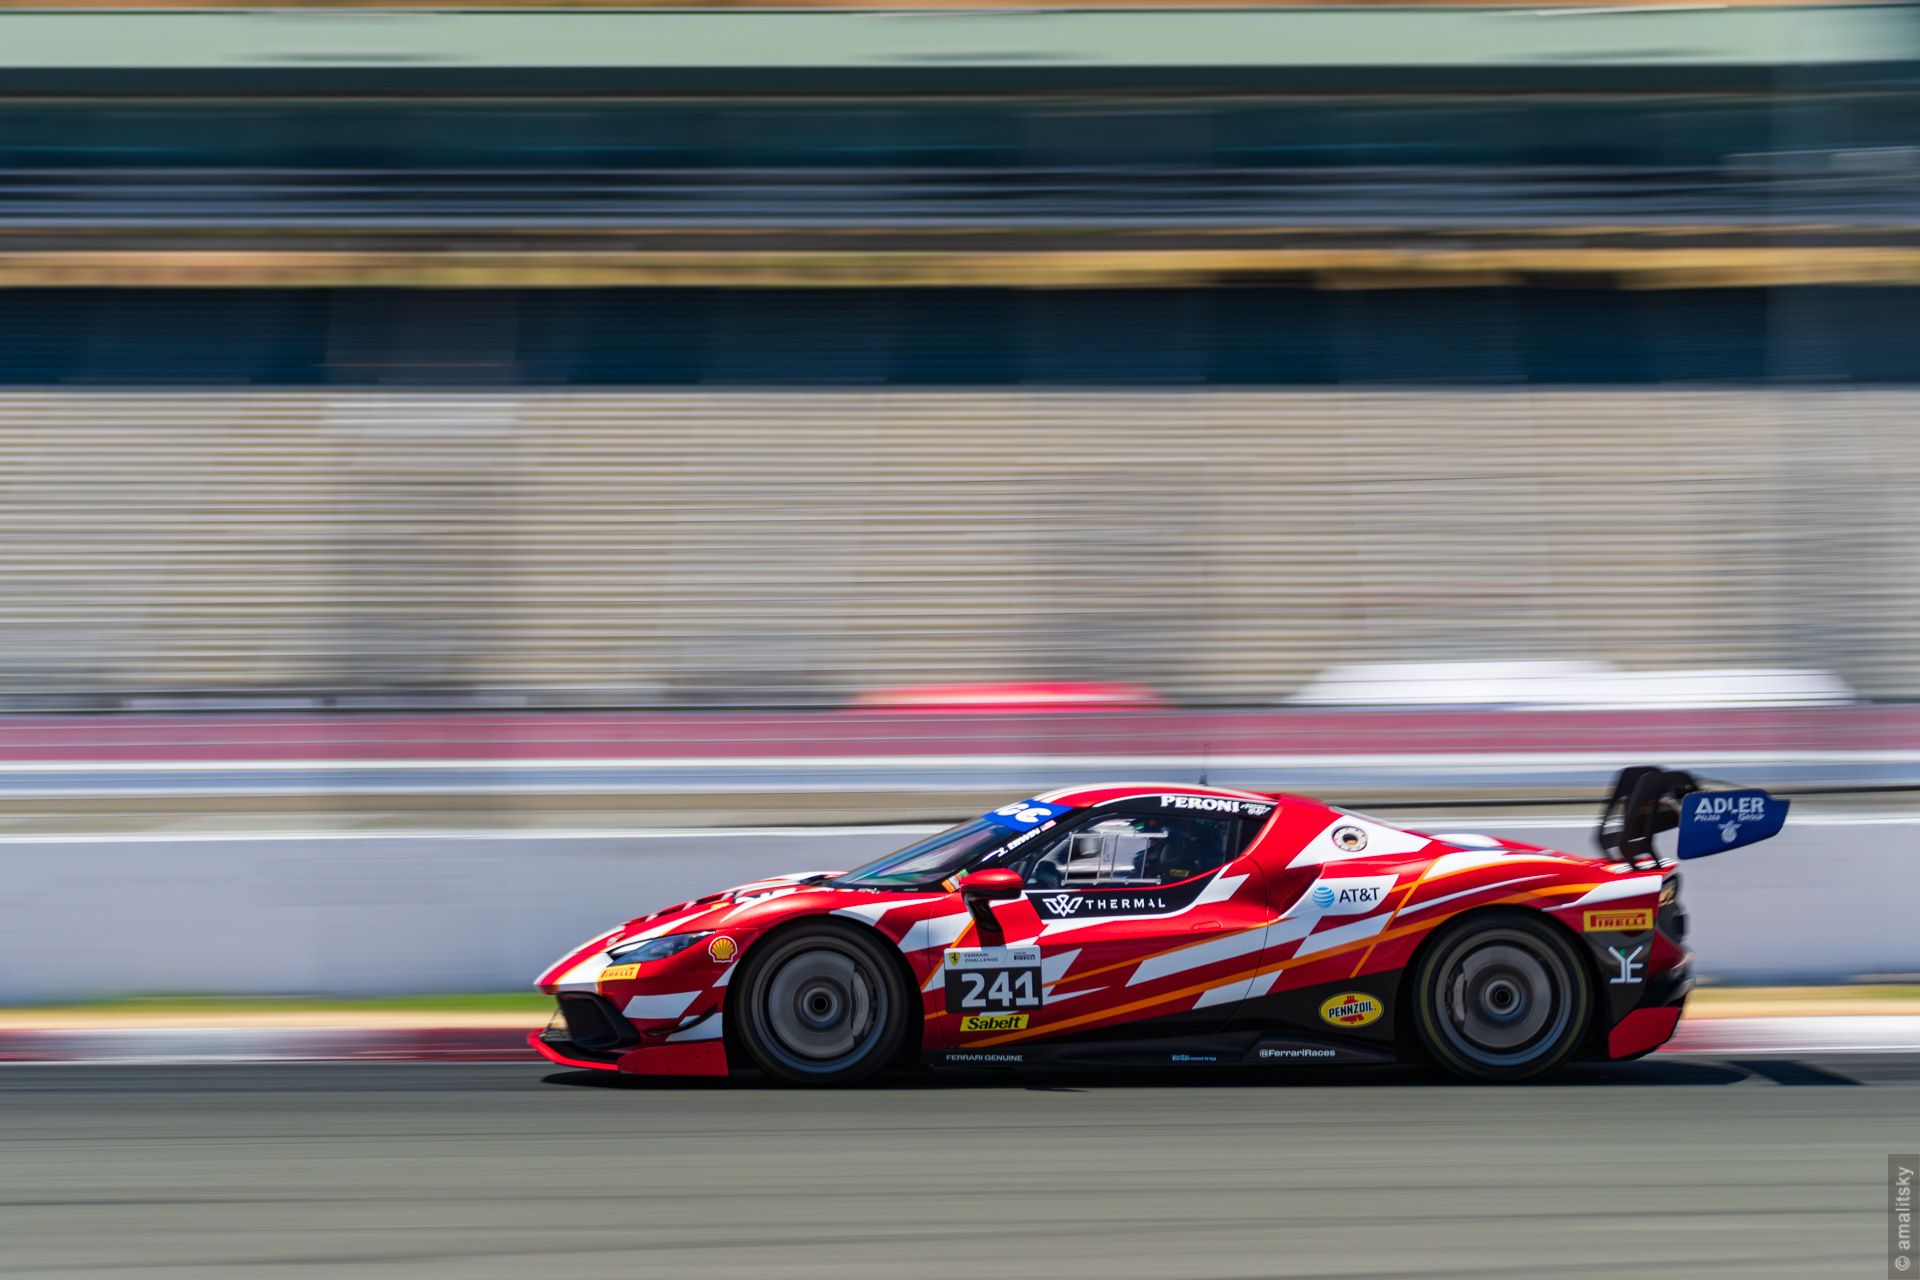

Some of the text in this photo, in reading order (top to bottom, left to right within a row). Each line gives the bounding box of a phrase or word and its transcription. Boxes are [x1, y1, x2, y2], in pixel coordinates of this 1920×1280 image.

[1160, 795, 1240, 813] PERONI
[1694, 797, 1765, 815] ADLER
[1339, 887, 1380, 903] AT&T
[1085, 898, 1166, 910] THERMAL
[1589, 912, 1647, 928] PIRELLI
[600, 966, 636, 978] PIRELLI
[961, 970, 1039, 1008] 241
[1328, 1000, 1374, 1019] PENNZOIL
[967, 1016, 1022, 1031] Sabelt
[984, 1054, 1023, 1062] GENUINE
[1259, 1048, 1336, 1058] @FerrariRaces
